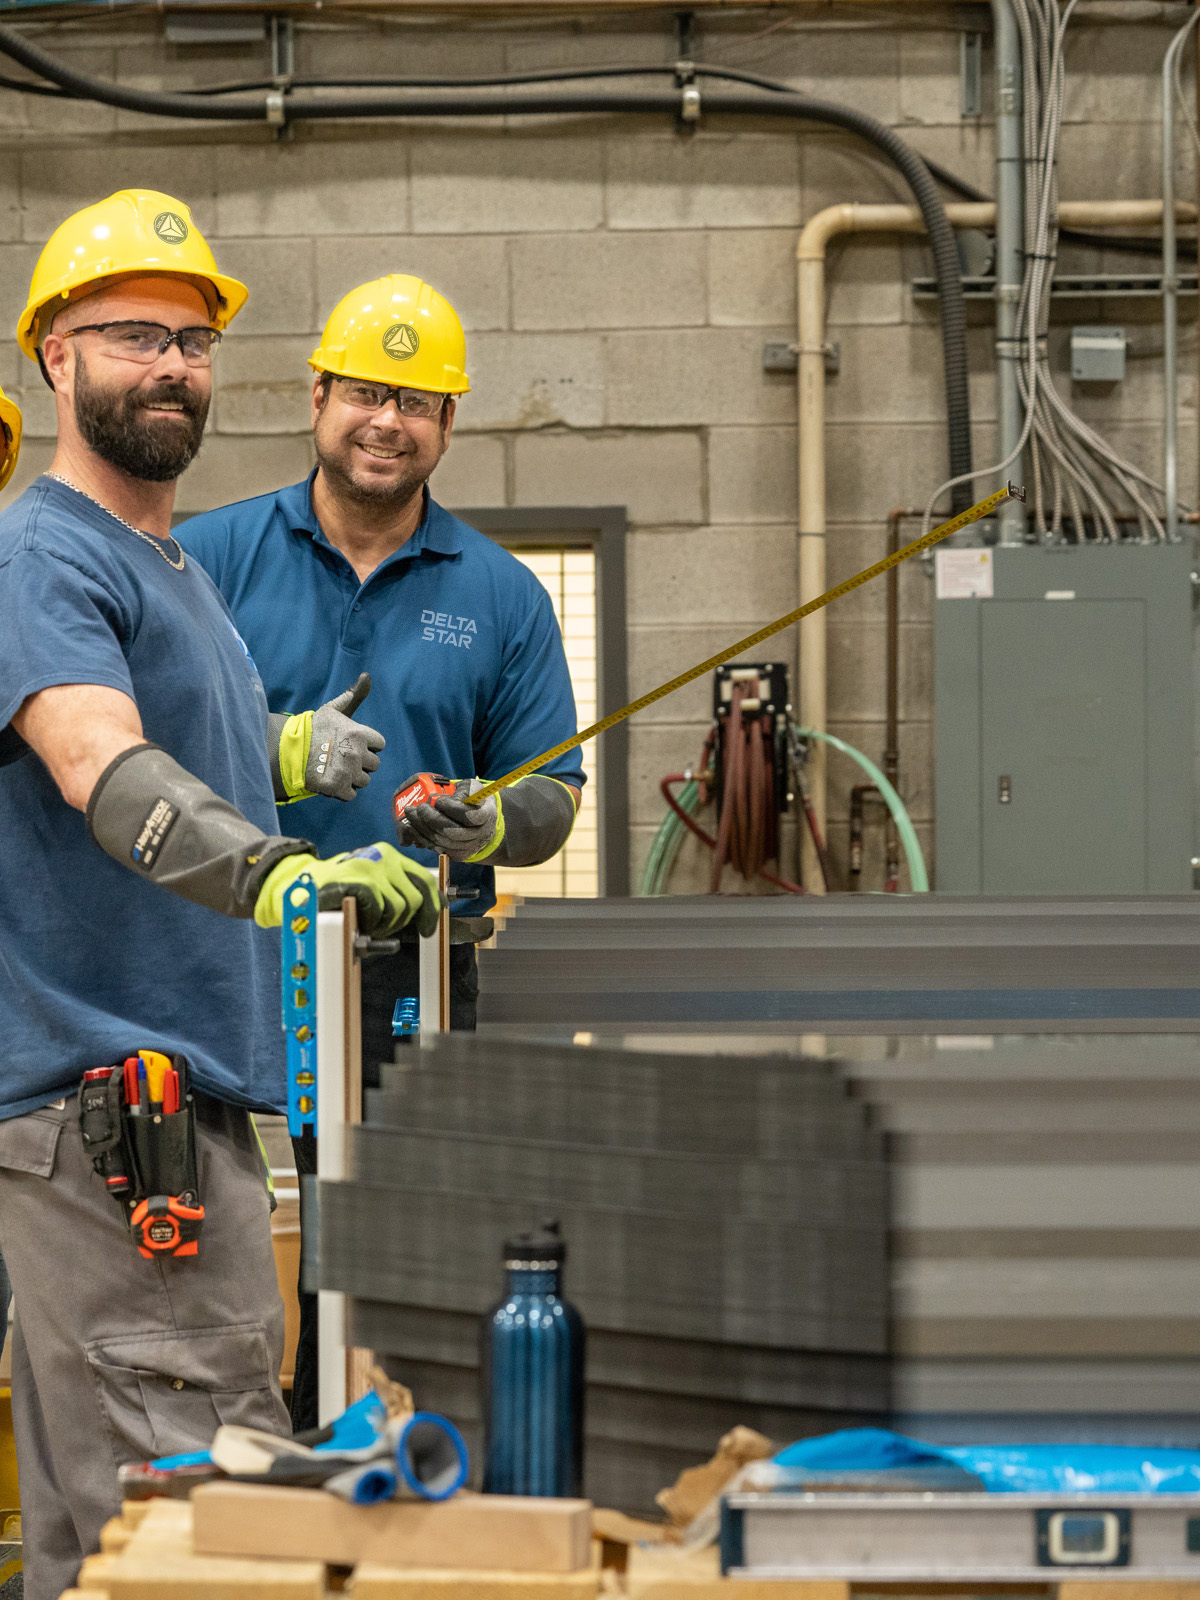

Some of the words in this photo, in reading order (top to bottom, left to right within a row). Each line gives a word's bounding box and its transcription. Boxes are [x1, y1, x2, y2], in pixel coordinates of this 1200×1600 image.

[386, 327, 399, 342] DELTA
[407, 330, 417, 346] STAR
[420, 609, 478, 634] DELTA
[421, 626, 473, 650] STAR
